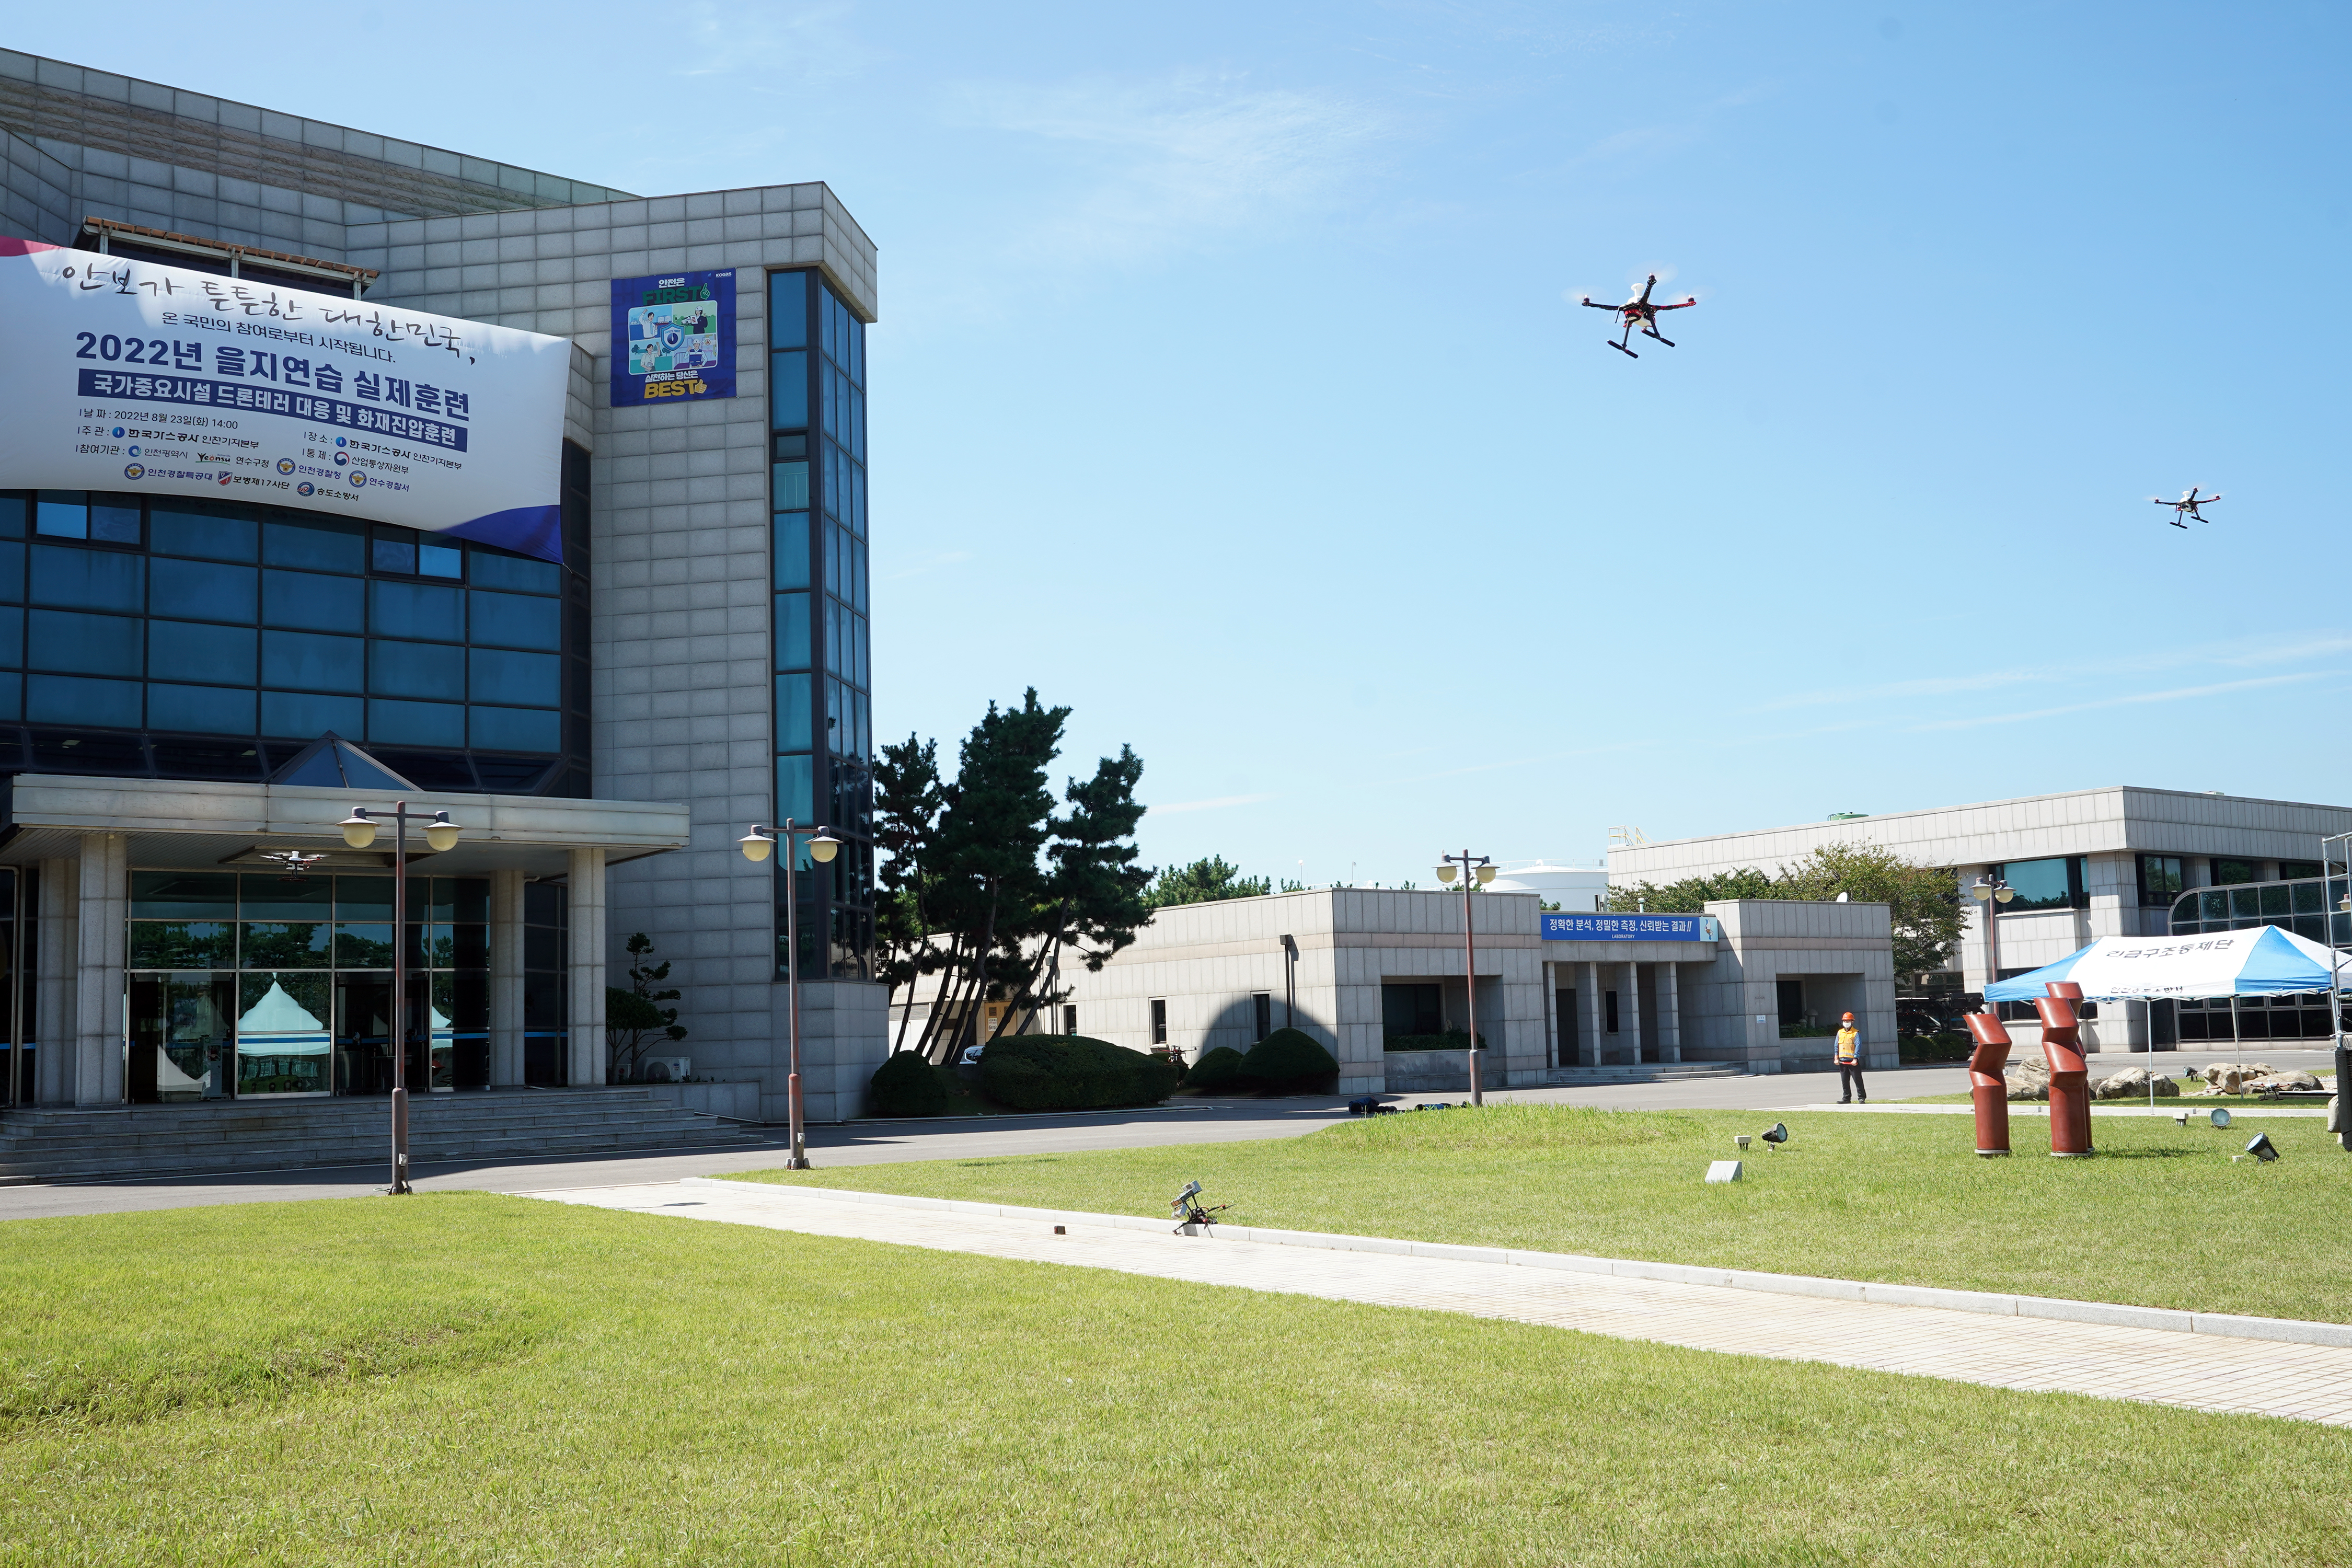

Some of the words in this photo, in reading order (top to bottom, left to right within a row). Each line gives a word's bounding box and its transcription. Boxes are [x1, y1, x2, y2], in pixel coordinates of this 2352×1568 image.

[659, 278, 685, 288] 안전은
[642, 286, 701, 306] FIRST
[62, 263, 185, 297] 안보가
[200, 281, 303, 320] 튼튼한
[318, 308, 476, 365] 대한민국,
[162, 312, 178, 325] 온
[183, 315, 231, 332] 국민의
[236, 322, 314, 347] 참여로부터
[318, 337, 396, 363] 시작됩니다.
[76, 331, 202, 372] 2022년
[215, 346, 343, 394] 을지연습
[354, 369, 469, 422] 실제훈련
[645, 373, 675, 383] 실천하는
[676, 370, 698, 380] 당신은
[644, 379, 698, 399] BEST
[94, 374, 211, 402] 국가중요시설
[217, 387, 290, 413] 드론테러
[295, 396, 330, 420] 대응
[336, 403, 352, 424] 및
[358, 408, 455, 446] 화재진압훈련
[114, 410, 149, 422] 2022년
[152, 413, 167, 423] 8월
[170, 415, 209, 427] 23일(화)
[212, 419, 238, 429] 14:00
[129, 429, 199, 443] 한국가스공사
[202, 436, 259, 449] 인천기지본부
[79, 444, 120, 455] 참여기관
[144, 448, 188, 459] 인천광역시
[197, 452, 230, 463] Yeonsu
[236, 457, 269, 468] 연수구청
[350, 440, 411, 459] 한국가스공사
[413, 453, 462, 470] 인천기지본부
[298, 465, 341, 480] 인천경찰청
[352, 456, 409, 475] 산업통상자원부
[148, 469, 213, 481] 인천경찰특공대
[233, 475, 290, 490] 보병제17사단
[369, 477, 410, 492] 연수경찰서
[317, 488, 359, 502] 송도소방서
[1550, 919, 1574, 931] 정확한
[1576, 919, 1594, 931] 분석,
[1595, 920, 1619, 931] 정밀한
[1621, 920, 1638, 932] 측정,
[1640, 920, 1669, 932] 신뢰받는
[1671, 921, 1692, 933] 결과!!
[2106, 940, 2235, 958] 긴급구조통제단
